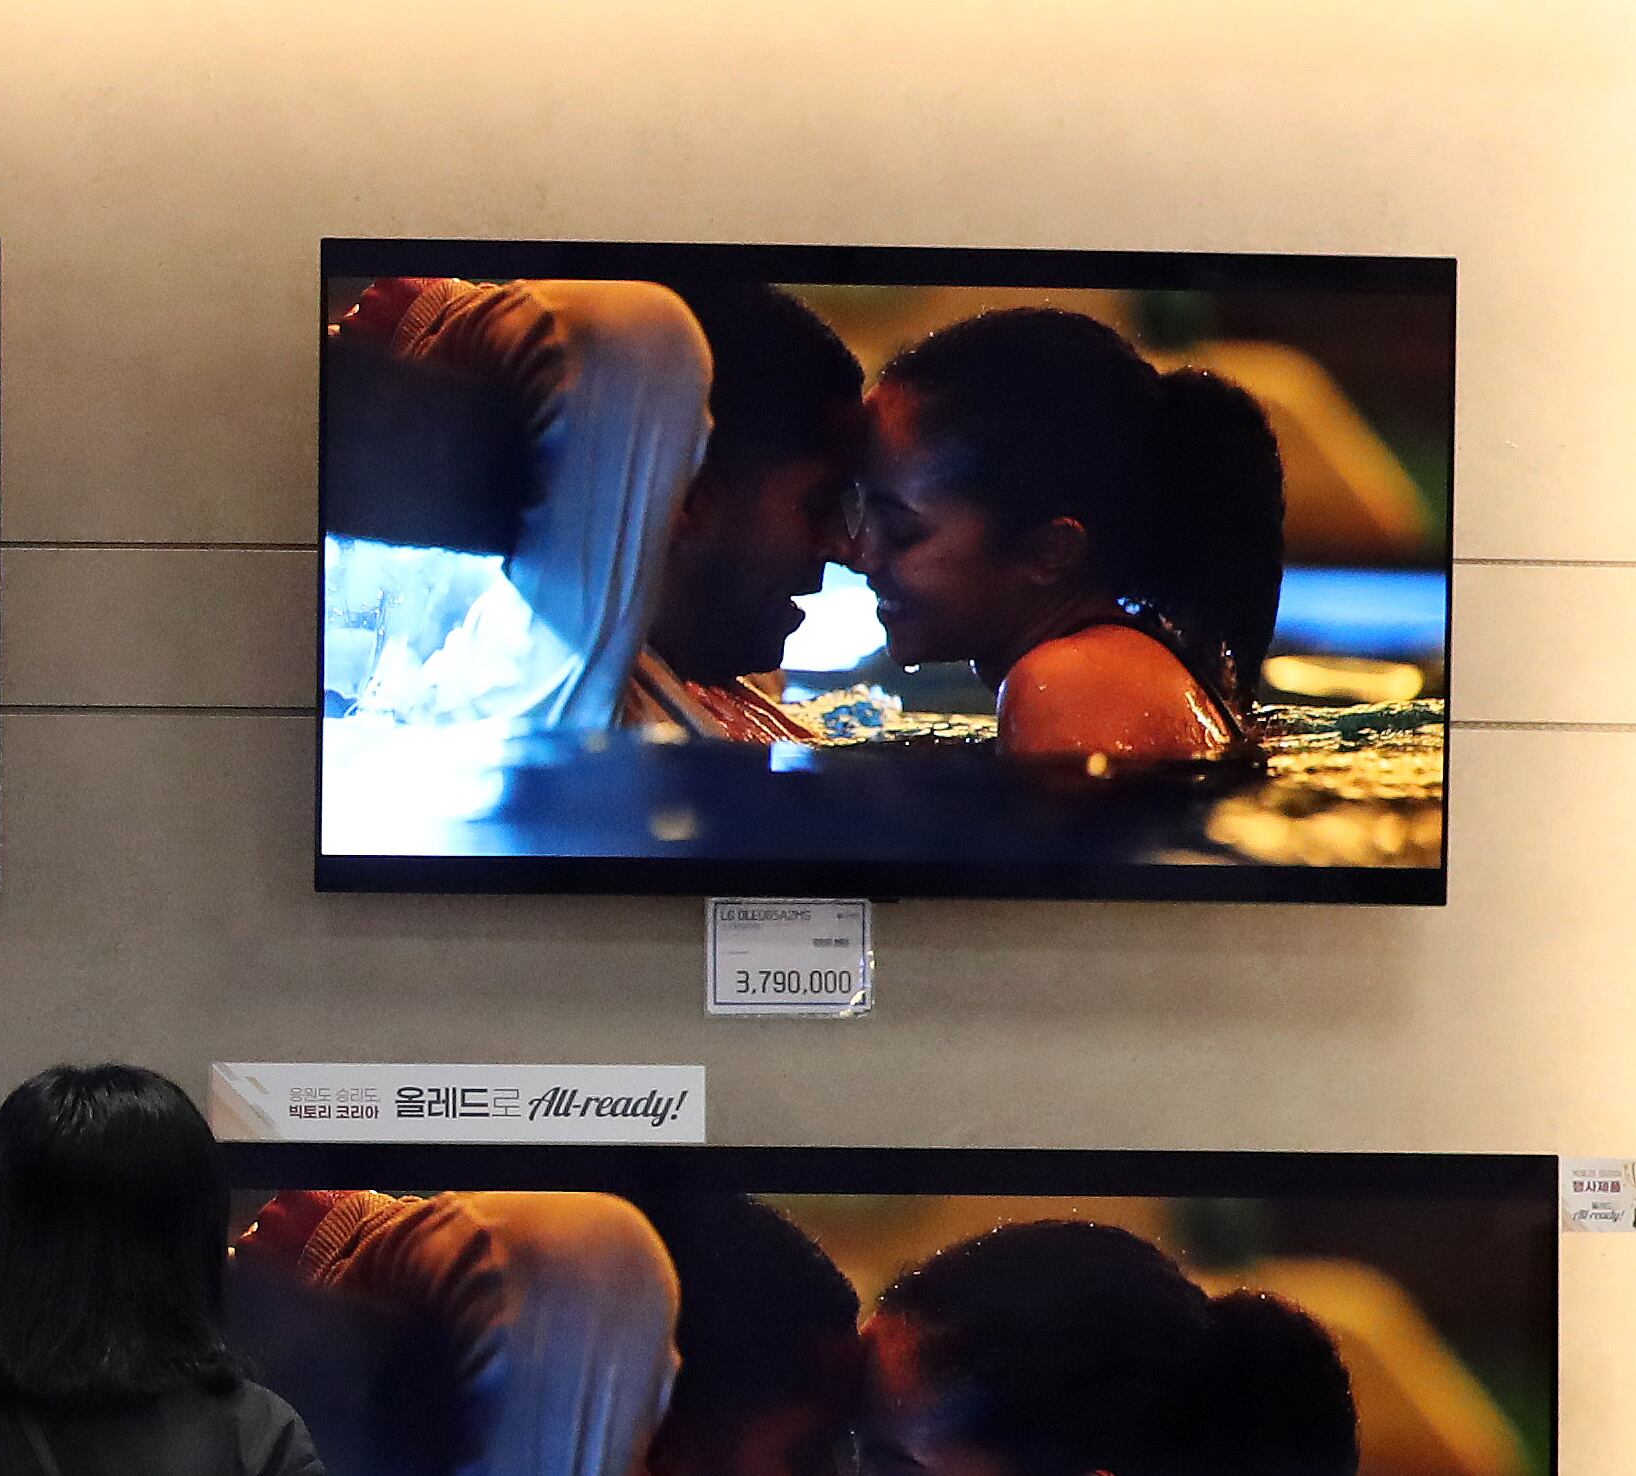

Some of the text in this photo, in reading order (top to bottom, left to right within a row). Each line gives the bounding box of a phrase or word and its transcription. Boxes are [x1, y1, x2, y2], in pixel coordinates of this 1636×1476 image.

[736, 970, 851, 994] 3,790,000
[289, 1105, 379, 1119] 빅토리 코리아
[395, 1086, 688, 1127] 올레드로 All-ready!
